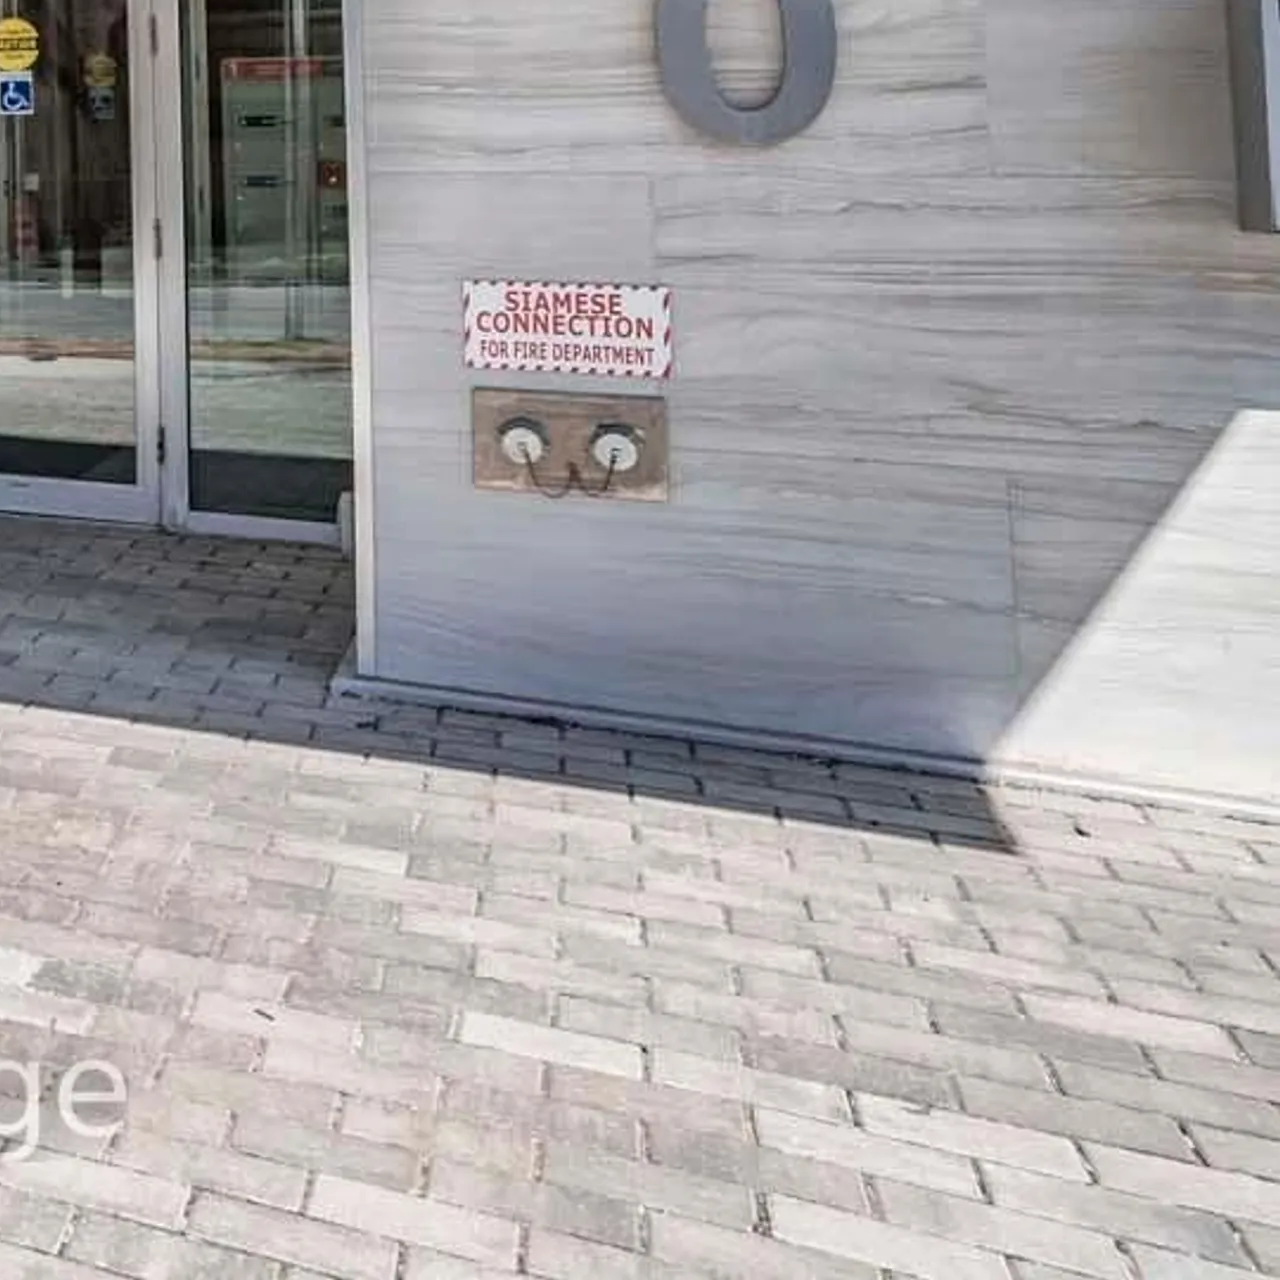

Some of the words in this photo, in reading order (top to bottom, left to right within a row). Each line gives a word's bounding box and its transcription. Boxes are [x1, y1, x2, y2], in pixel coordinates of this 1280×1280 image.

[504, 291, 622, 315] SIAMESE
[476, 311, 654, 339] CONNECTION
[480, 340, 510, 360] FOR
[513, 342, 547, 361] FIRE
[551, 343, 655, 366] DEPARTMENT
